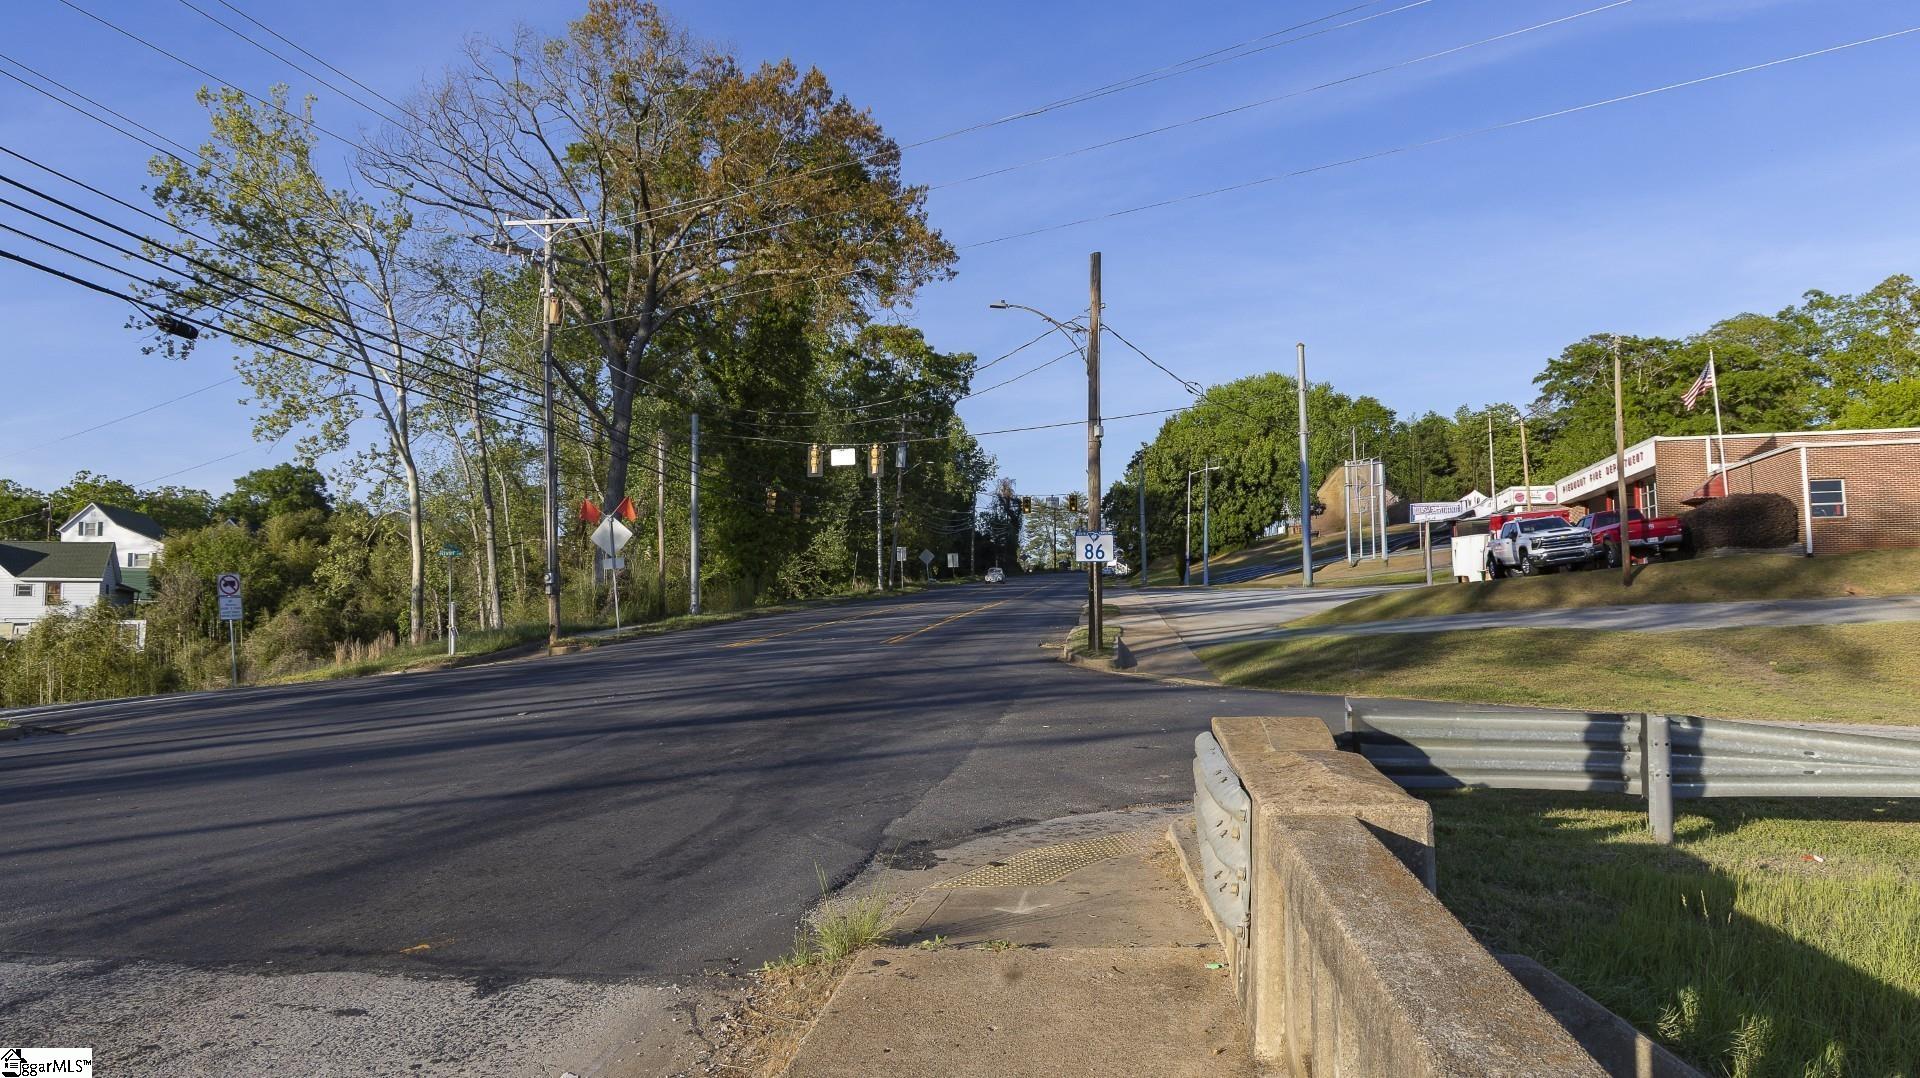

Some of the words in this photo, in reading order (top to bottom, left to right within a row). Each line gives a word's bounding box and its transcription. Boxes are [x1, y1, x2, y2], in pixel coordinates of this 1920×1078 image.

[1589, 470, 1602, 483] FIRE
[1605, 451, 1644, 476] DEPTMENT
[1085, 543, 1105, 560] 86
